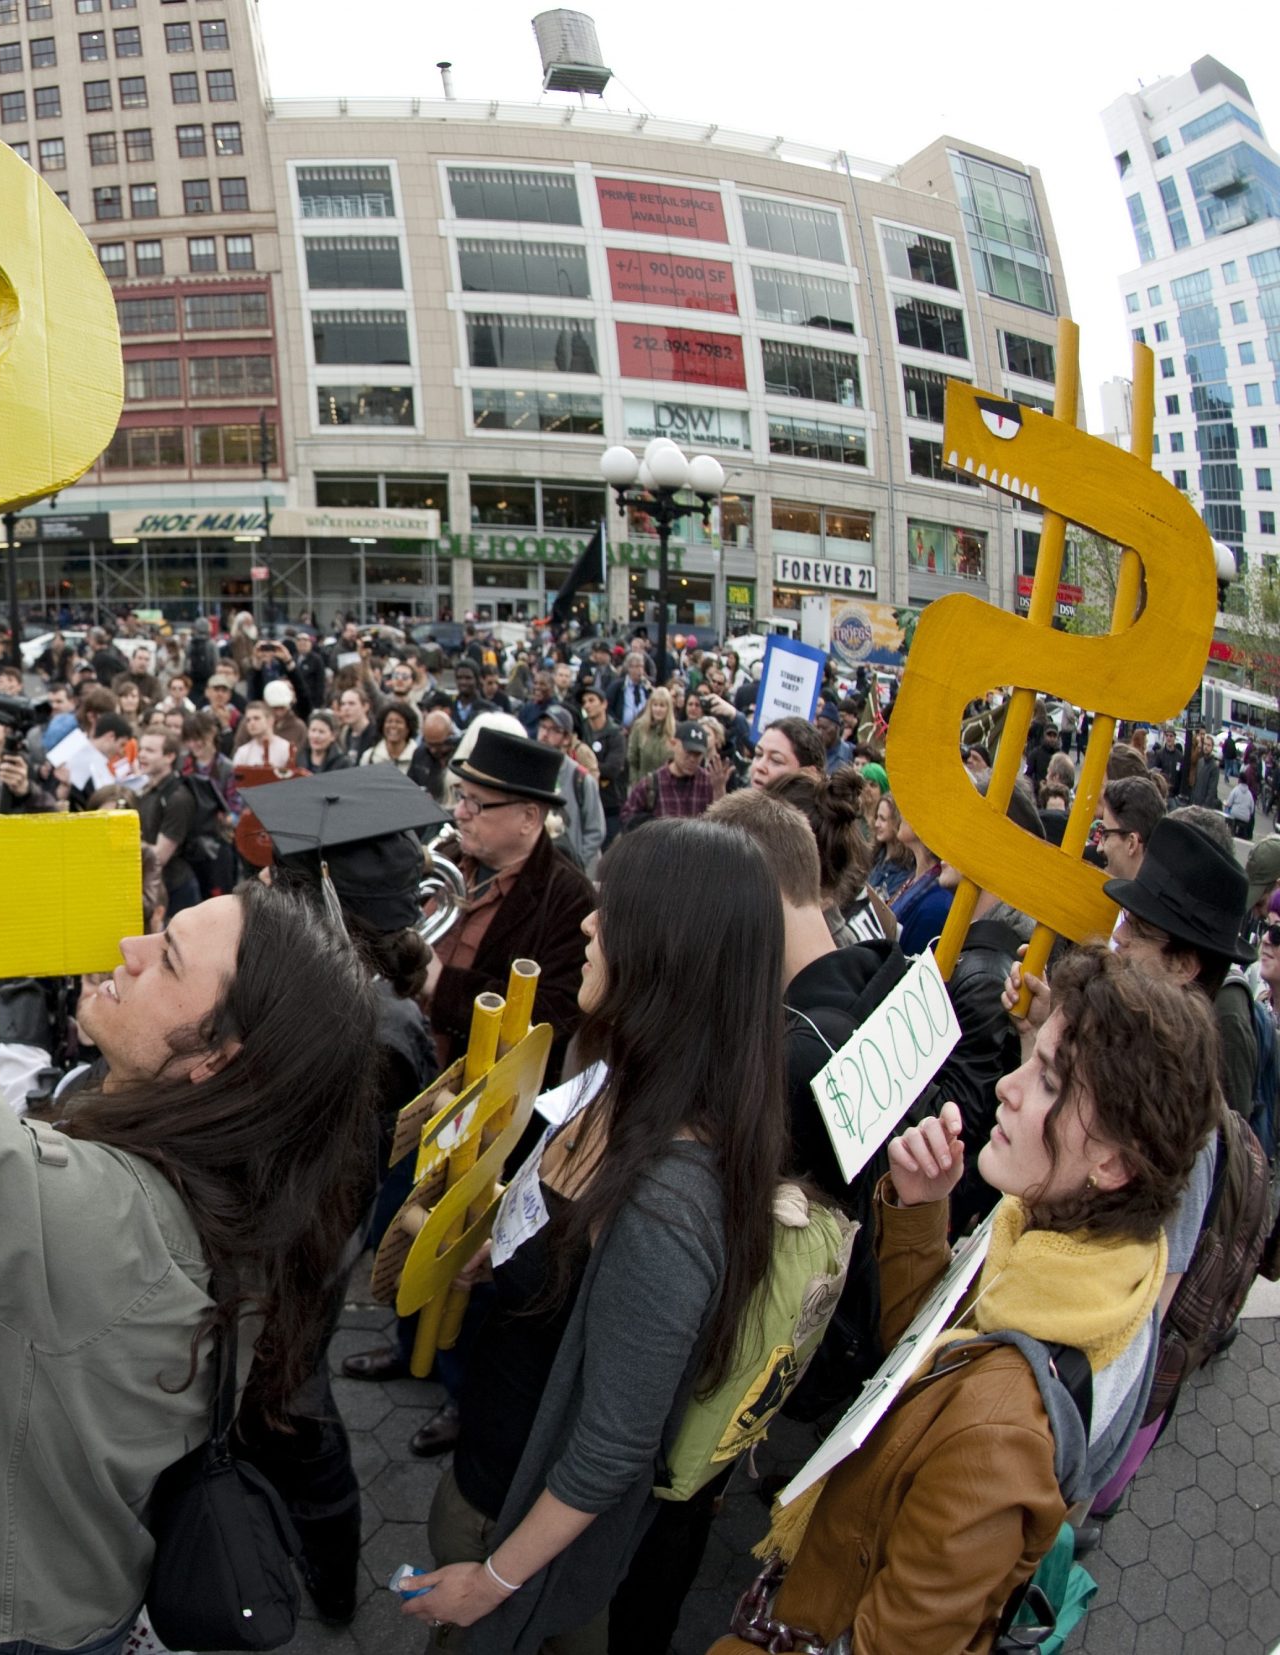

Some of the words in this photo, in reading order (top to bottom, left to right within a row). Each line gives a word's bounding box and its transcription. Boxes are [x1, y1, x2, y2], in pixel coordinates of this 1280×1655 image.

[601, 189, 636, 202] PRIME
[640, 193, 677, 208] RETAIL
[678, 199, 715, 212] SPACE
[632, 211, 697, 228] AVAILABLE
[650, 262, 705, 281] 90,000
[709, 269, 726, 283] SF
[633, 335, 734, 360] 212.894.7982
[654, 403, 715, 431] DSW
[693, 433, 740, 447] WAREHOUSE
[134, 513, 195, 534] SHOE
[196, 513, 273, 531] MANIA
[489, 535, 571, 562] FOODS
[781, 559, 852, 587] FOREVER
[858, 569, 873, 589] 21
[780, 670, 805, 684] STUDENT
[825, 963, 949, 1145] $20,000
